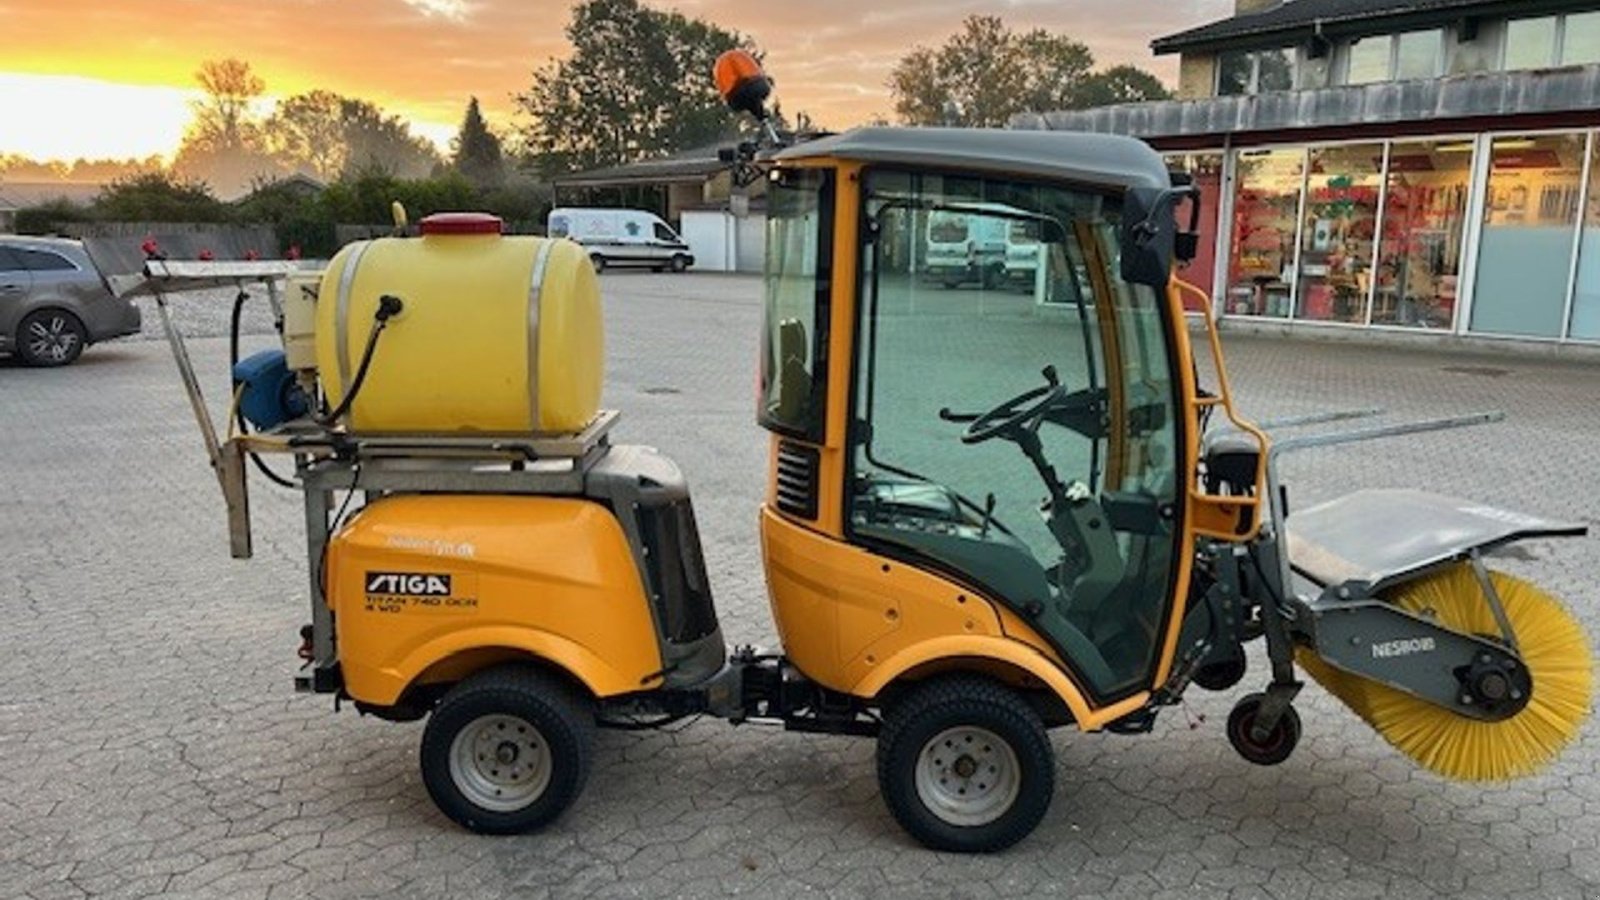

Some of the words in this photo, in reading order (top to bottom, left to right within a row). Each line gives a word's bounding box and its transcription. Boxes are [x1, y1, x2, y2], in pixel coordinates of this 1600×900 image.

[368, 574, 449, 594] STIGA
[366, 596, 406, 605] TITAN
[409, 598, 441, 606] 740
